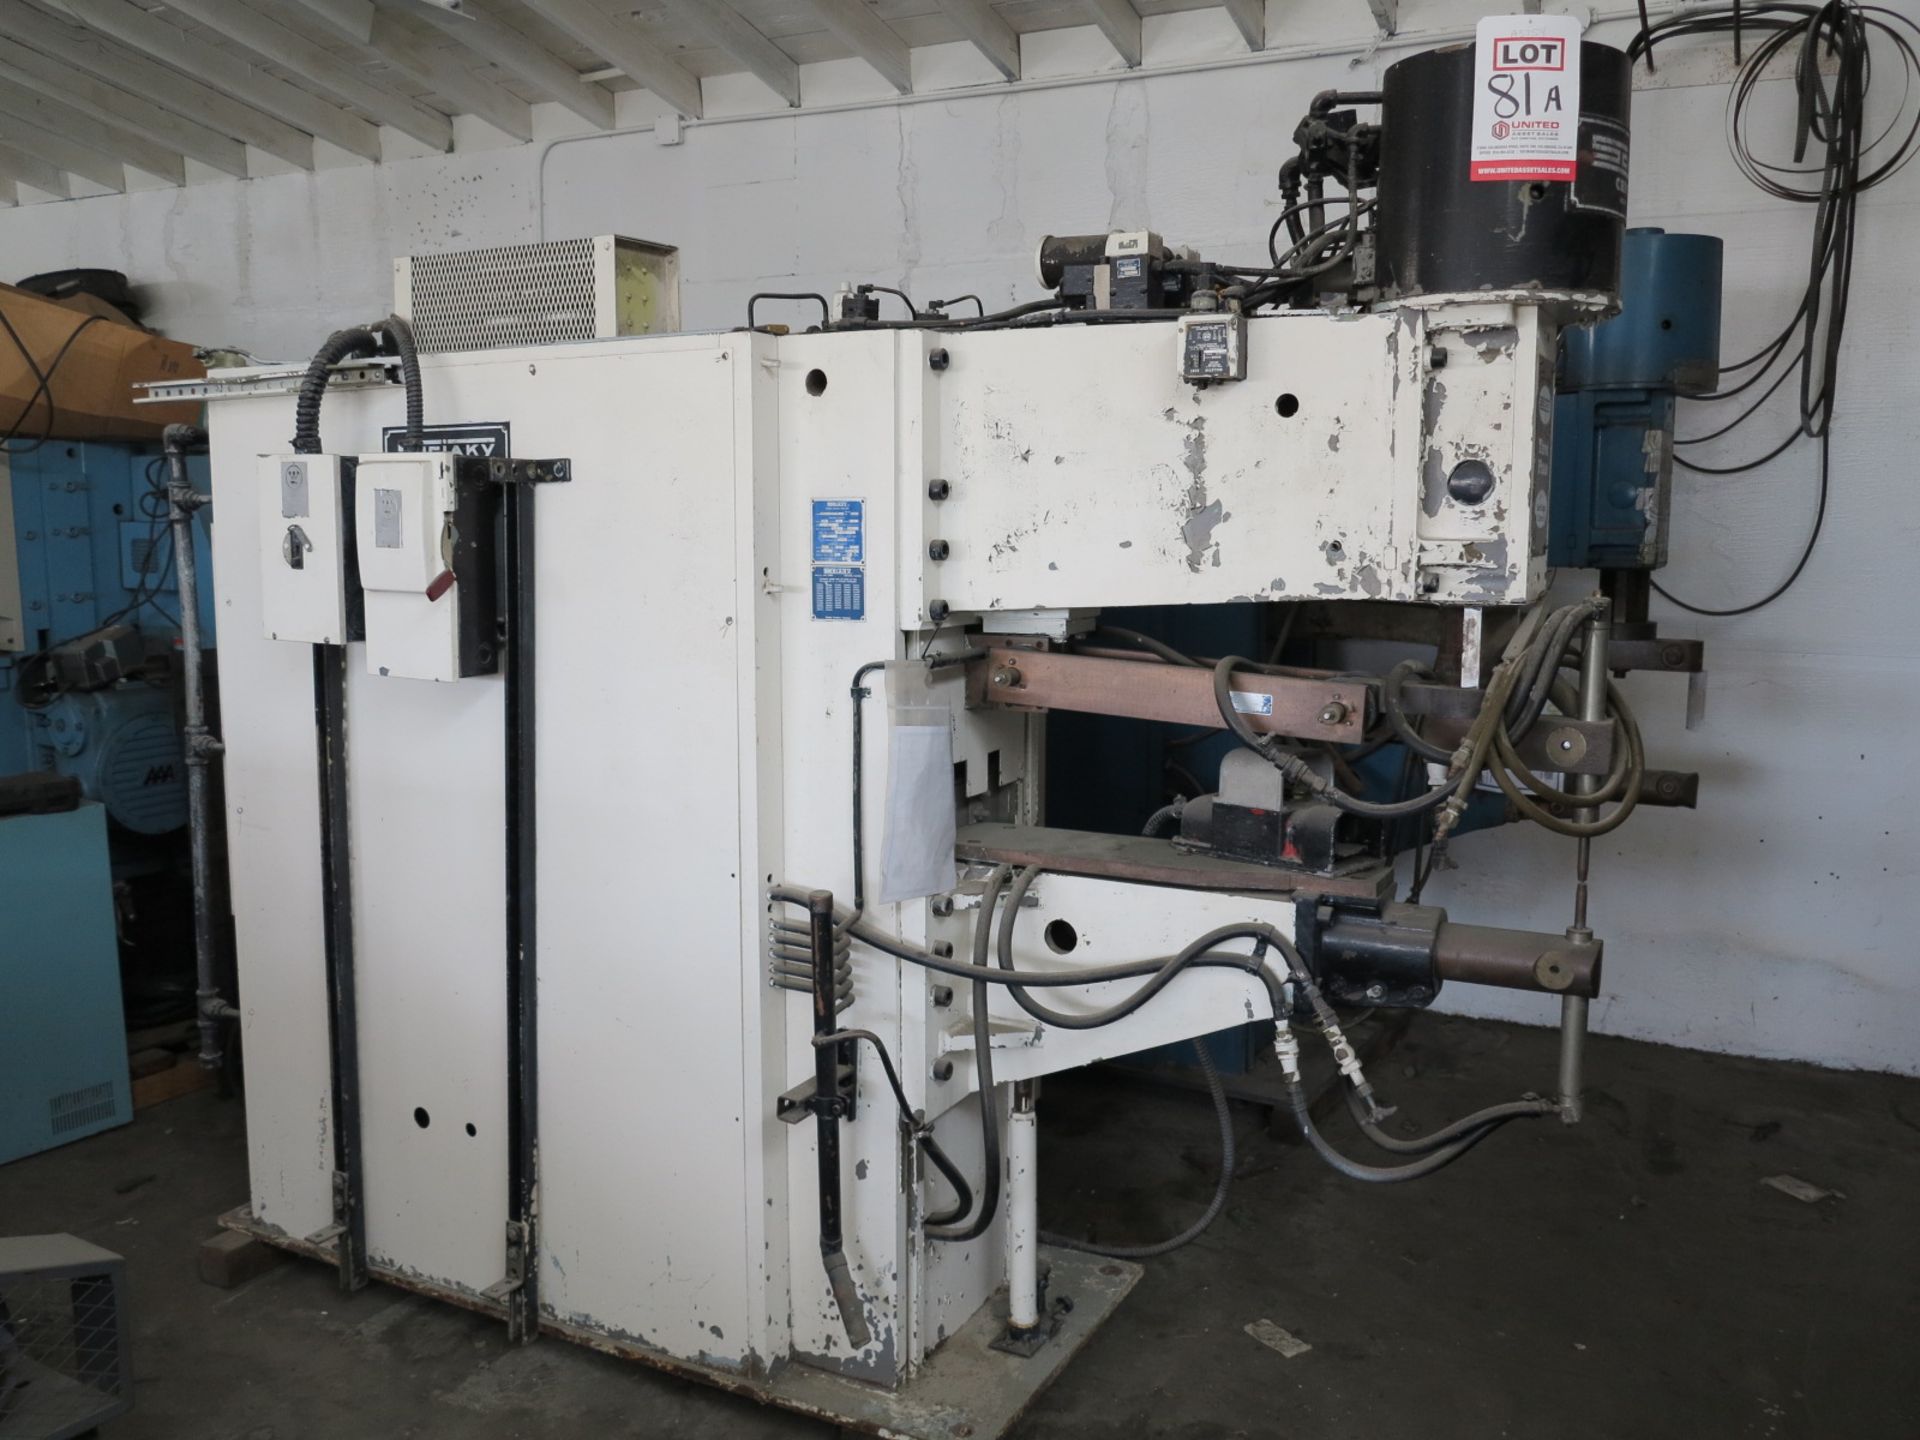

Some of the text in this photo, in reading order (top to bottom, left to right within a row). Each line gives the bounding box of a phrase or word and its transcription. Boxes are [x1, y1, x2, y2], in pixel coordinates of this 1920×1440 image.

[1502, 44, 1557, 64] LOT
[1487, 72, 1562, 119] 81 A
[1511, 121, 1560, 129] UNITED
[397, 441, 496, 457] IAKY
